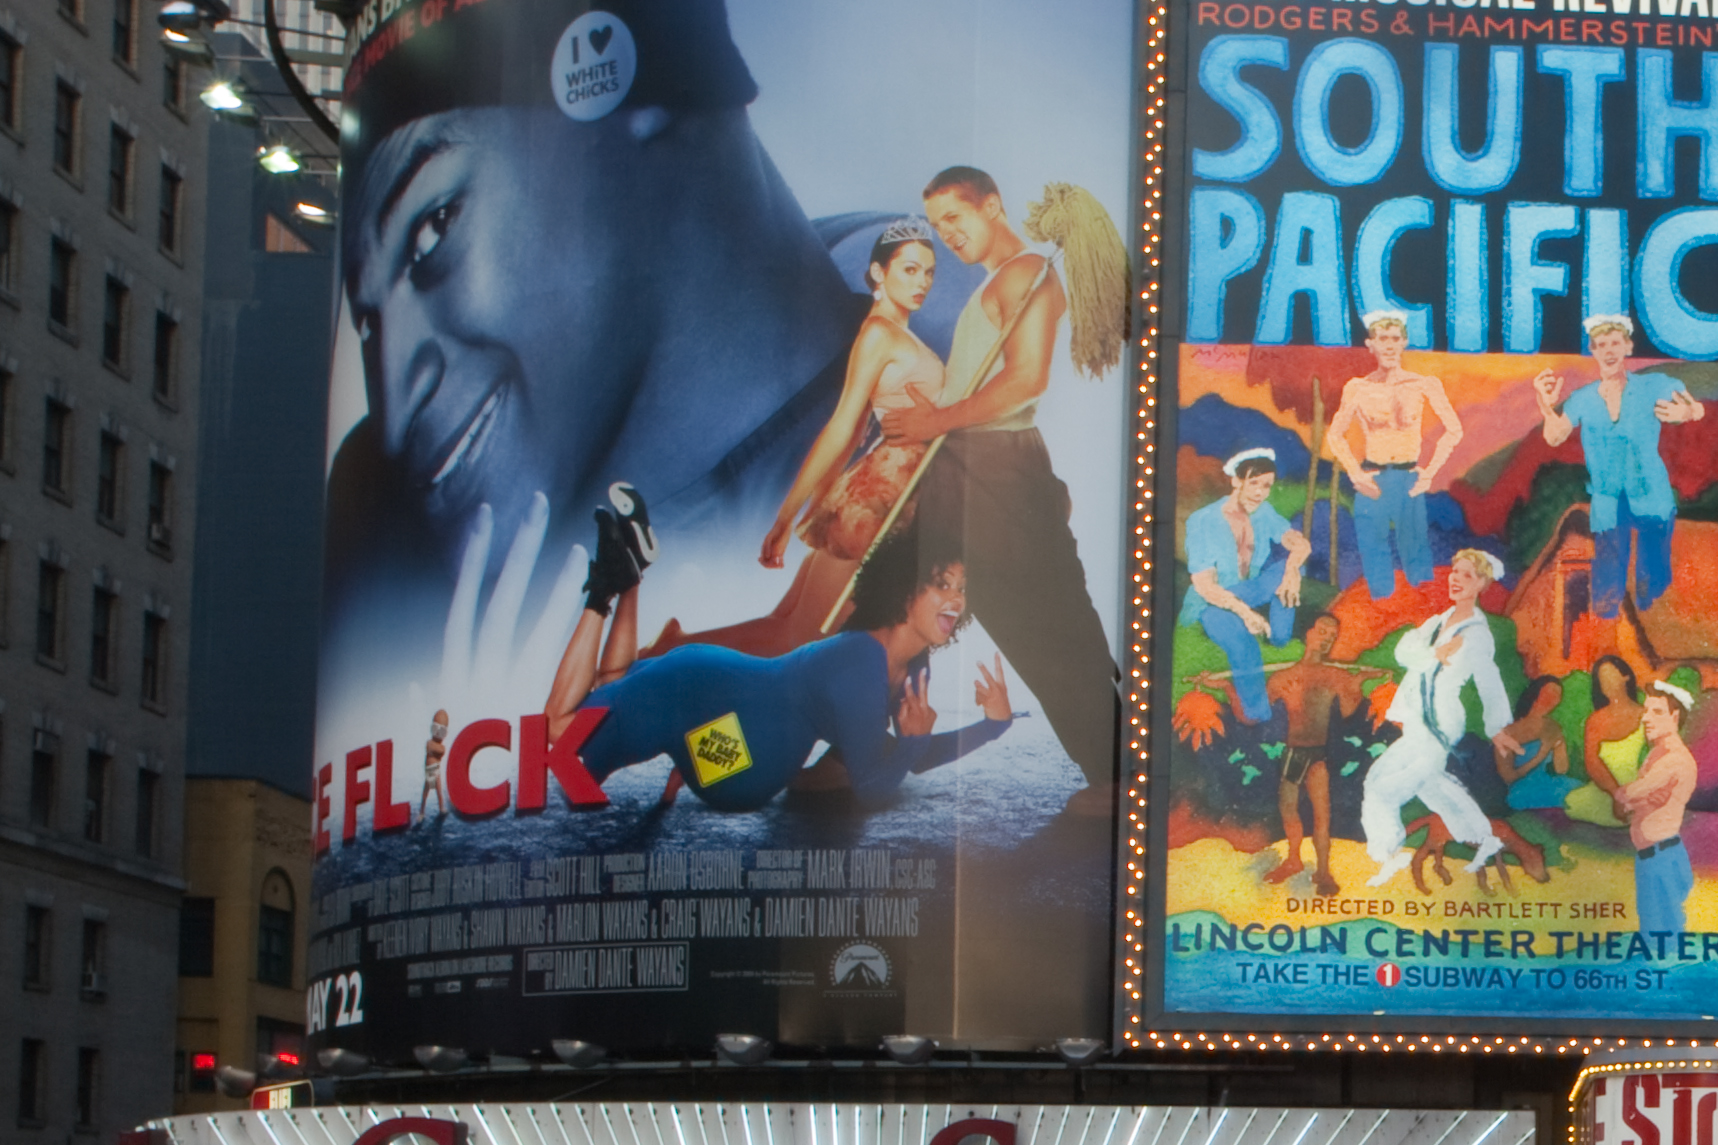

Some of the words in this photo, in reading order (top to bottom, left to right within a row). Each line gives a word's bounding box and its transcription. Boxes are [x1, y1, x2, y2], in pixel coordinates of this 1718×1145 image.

[1198, 2, 1380, 33] RODGERS
[1389, 10, 1414, 35] &
[545, 857, 577, 898] SCOTT
[579, 855, 601, 895] HILL
[647, 850, 688, 890] AARON
[806, 849, 846, 889] MARK
[556, 902, 600, 942] MARLON
[602, 900, 648, 940] WAYANS
[661, 898, 697, 938] CRAIG
[699, 897, 750, 938] WAYANS
[765, 897, 814, 937] DAMIEN
[818, 897, 859, 937] DANTE
[863, 897, 919, 937] WAYANS
[1286, 897, 1395, 915] DIRECTED
[1405, 900, 1433, 917] BY
[1443, 901, 1560, 919] BARTLETT
[1569, 902, 1627, 919] SHER
[1171, 922, 1348, 955] LINCOLN
[1364, 926, 1537, 958] CENTER
[555, 950, 596, 990] DAMIEN
[598, 948, 633, 988] DANTE
[636, 946, 685, 986] WAYANS
[1236, 962, 1310, 985] TAKE
[1315, 963, 1369, 986] THE
[1404, 968, 1522, 989] SUBWAY
[1531, 968, 1567, 989] TO
[335, 971, 363, 1027] 22
